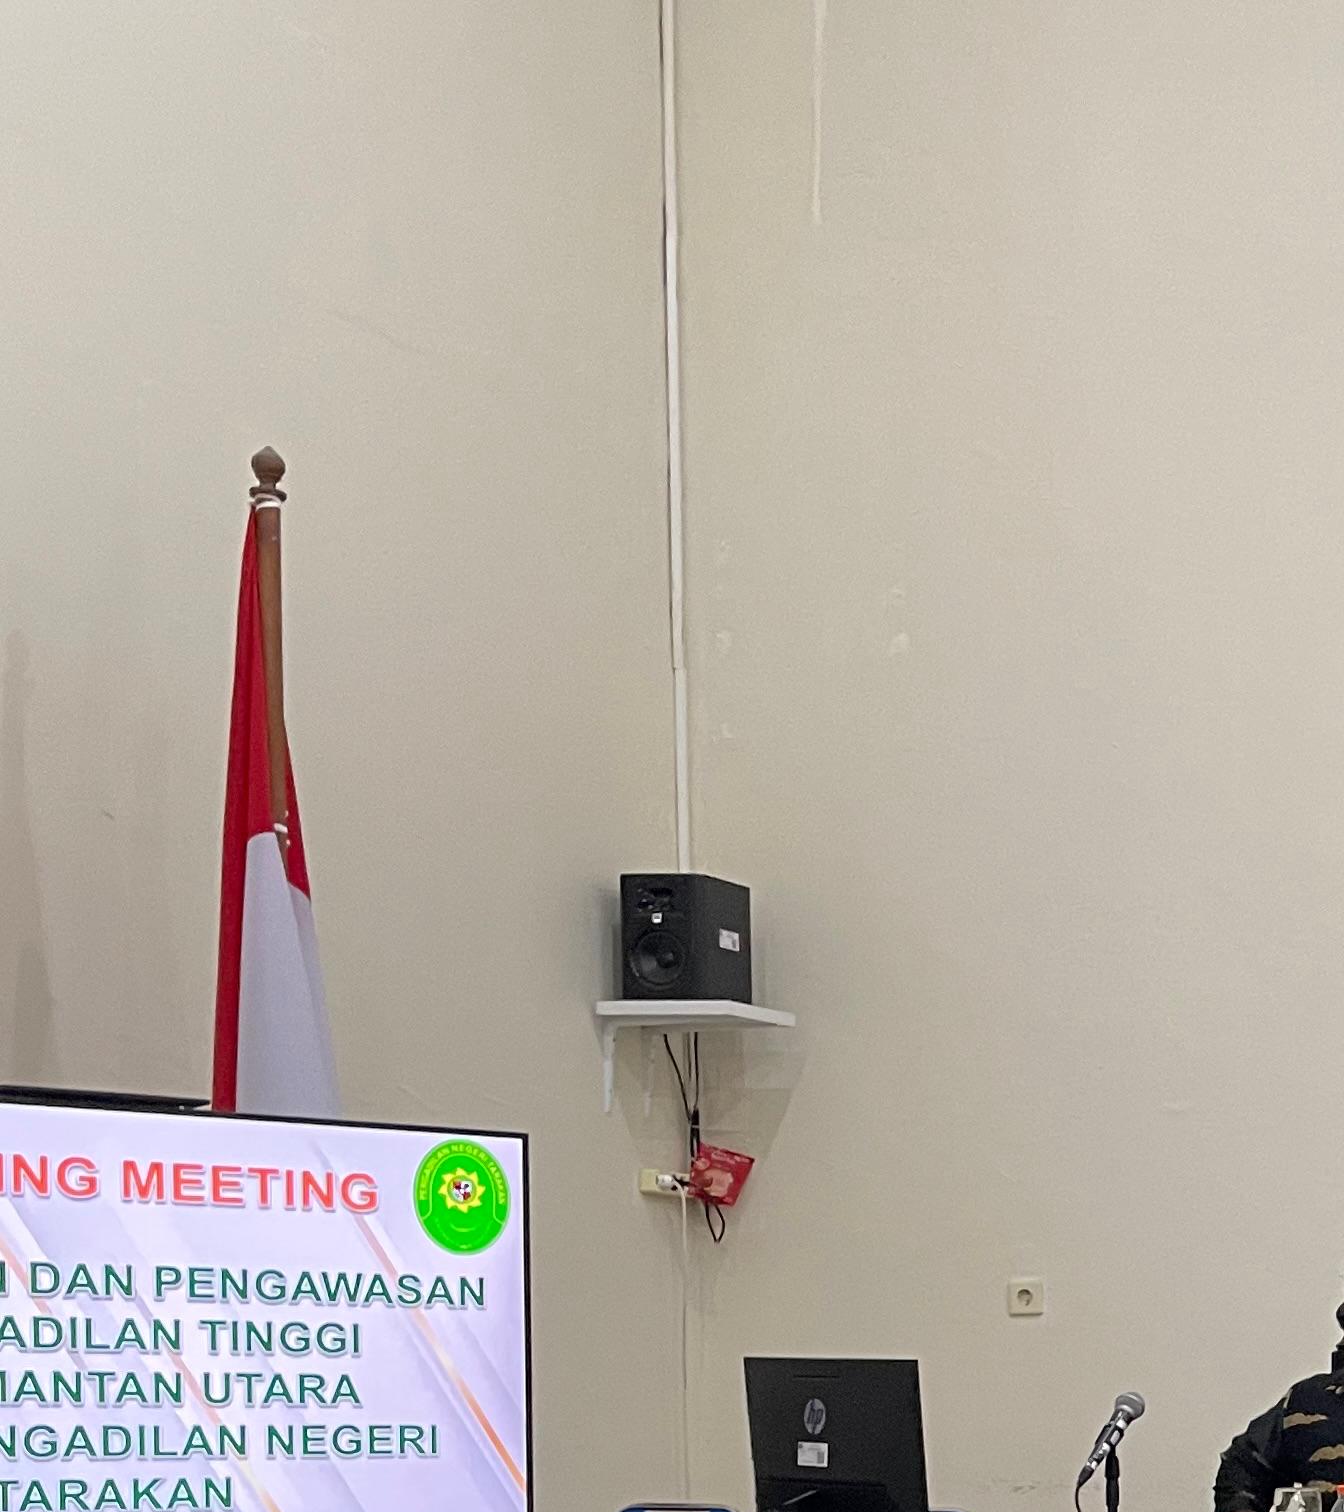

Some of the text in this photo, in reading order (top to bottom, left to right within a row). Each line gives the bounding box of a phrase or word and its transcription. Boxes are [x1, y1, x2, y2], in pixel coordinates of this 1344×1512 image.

[122, 1159, 379, 1213] MEETING
[30, 1262, 133, 1297] DAN
[155, 1265, 485, 1307] PENGAWASAN
[0, 1315, 361, 1355] ADILAN TINGGI
[0, 1370, 361, 1406] ANTAN UTARA
[267, 1424, 438, 1457] NEGERI
[0, 1477, 232, 1512] TARAKAN
